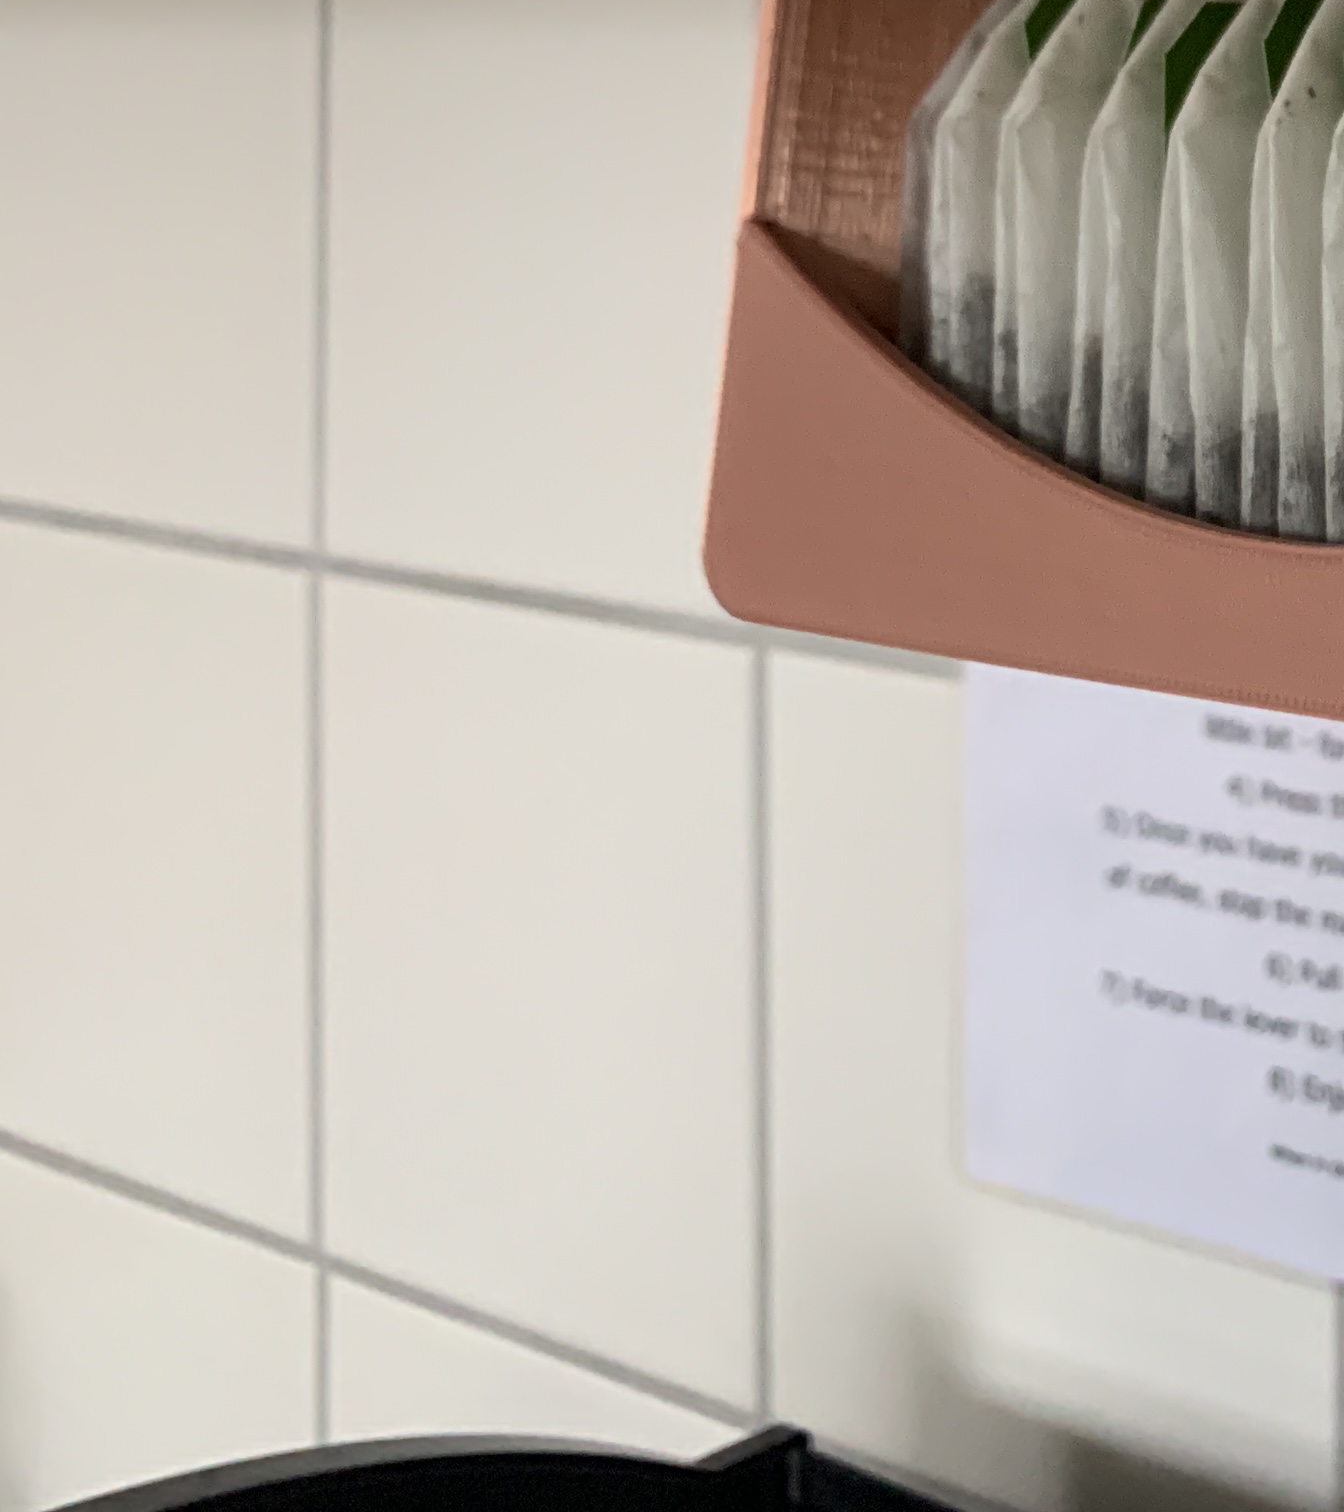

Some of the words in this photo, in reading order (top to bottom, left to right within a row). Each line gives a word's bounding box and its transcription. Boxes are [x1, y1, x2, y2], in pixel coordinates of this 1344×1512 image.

[1260, 779, 1323, 817] Press
[1273, 897, 1314, 929] the
[1200, 995, 1234, 1024] the
[1307, 1020, 1332, 1051] to
